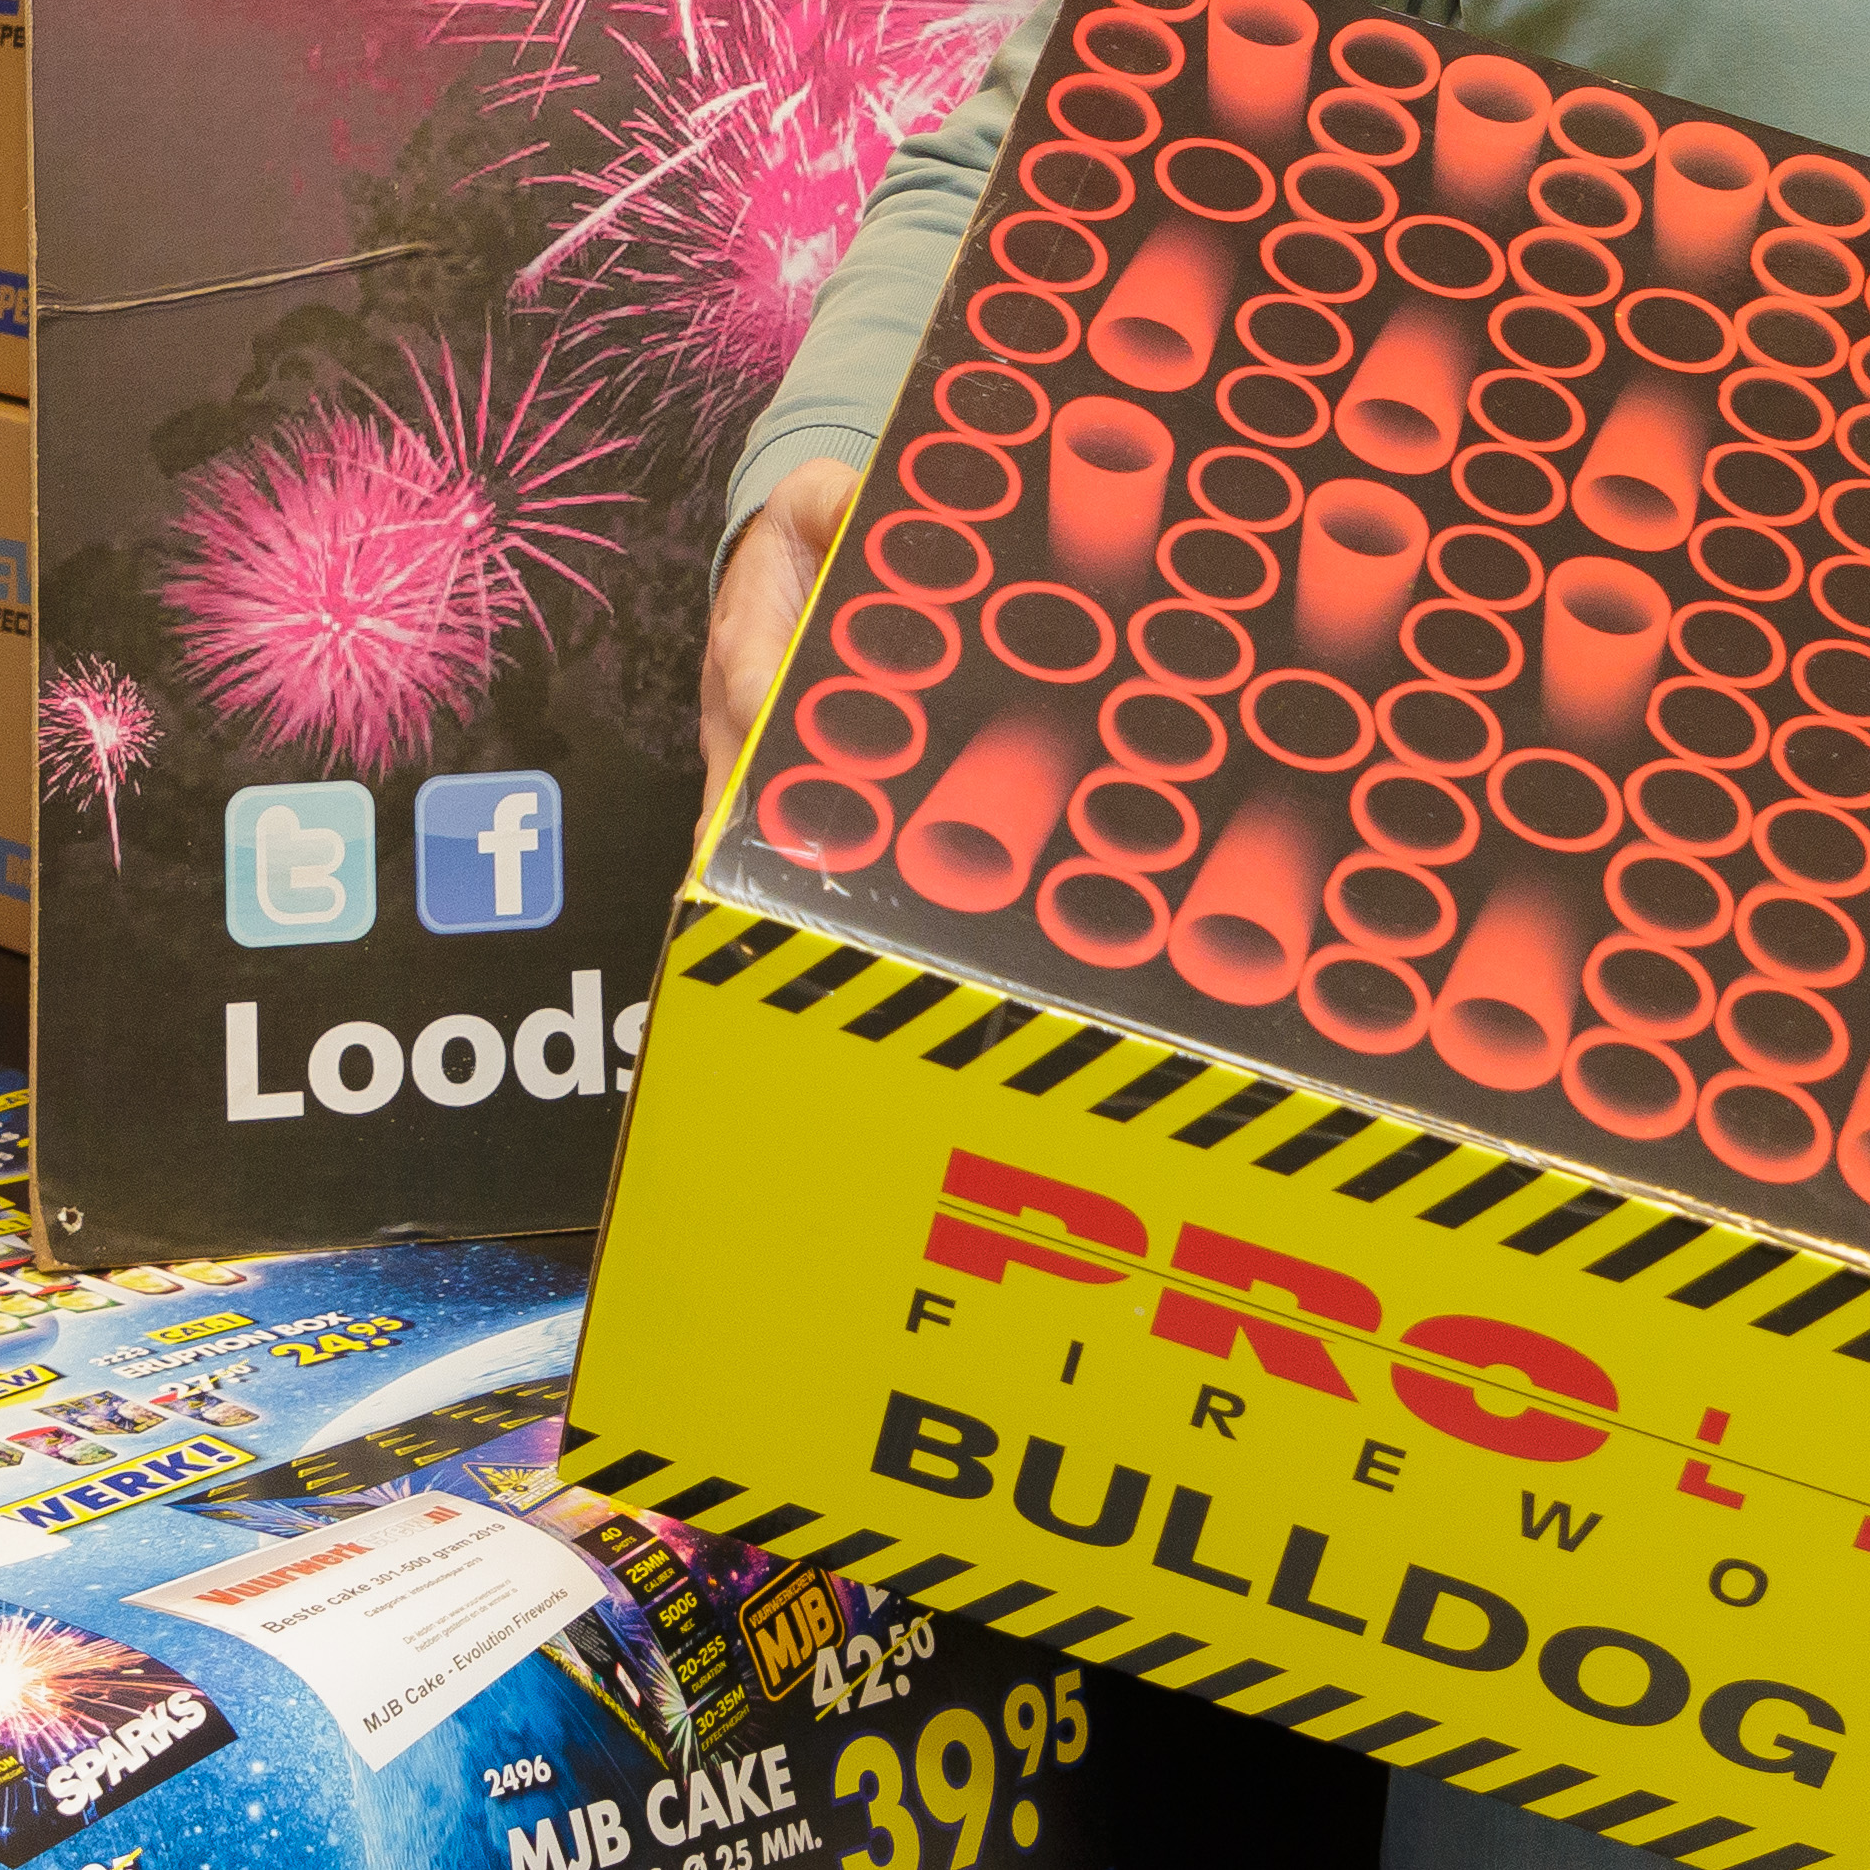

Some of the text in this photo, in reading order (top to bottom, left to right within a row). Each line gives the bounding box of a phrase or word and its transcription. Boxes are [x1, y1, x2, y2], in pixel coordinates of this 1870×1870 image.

[112, 1310, 355, 1379] ERUPTION BOX
[158, 1313, 241, 1343] CAT.1
[270, 1316, 406, 1368] 24.95
[193, 1505, 463, 1607] Vuurwerkcrew.nl
[600, 1527, 623, 1543] 40
[261, 1521, 507, 1636] Beste cake 301-500 gram 2019
[625, 1549, 670, 1585] 25MM
[642, 1567, 677, 1593] CALIBER
[870, 1389, 1847, 1790] BULLDOG
[658, 1591, 698, 1629] 500G
[756, 1585, 835, 1688] MJB
[362, 1701, 405, 1736] MJB
[405, 1671, 447, 1707] Cake
[453, 1626, 515, 1672] Evolution
[511, 1586, 569, 1636] Fireworks
[677, 1634, 728, 1685] 20-25S
[690, 1660, 728, 1694] DURATION
[695, 1684, 747, 1738] 30-35M
[46, 1691, 207, 1817] SPARKS
[483, 1754, 553, 1799] 2496
[833, 1668, 1089, 1870] 39.95
[506, 1743, 798, 1870] MJB CAKE
[715, 1818, 824, 1870] 25 MM.
